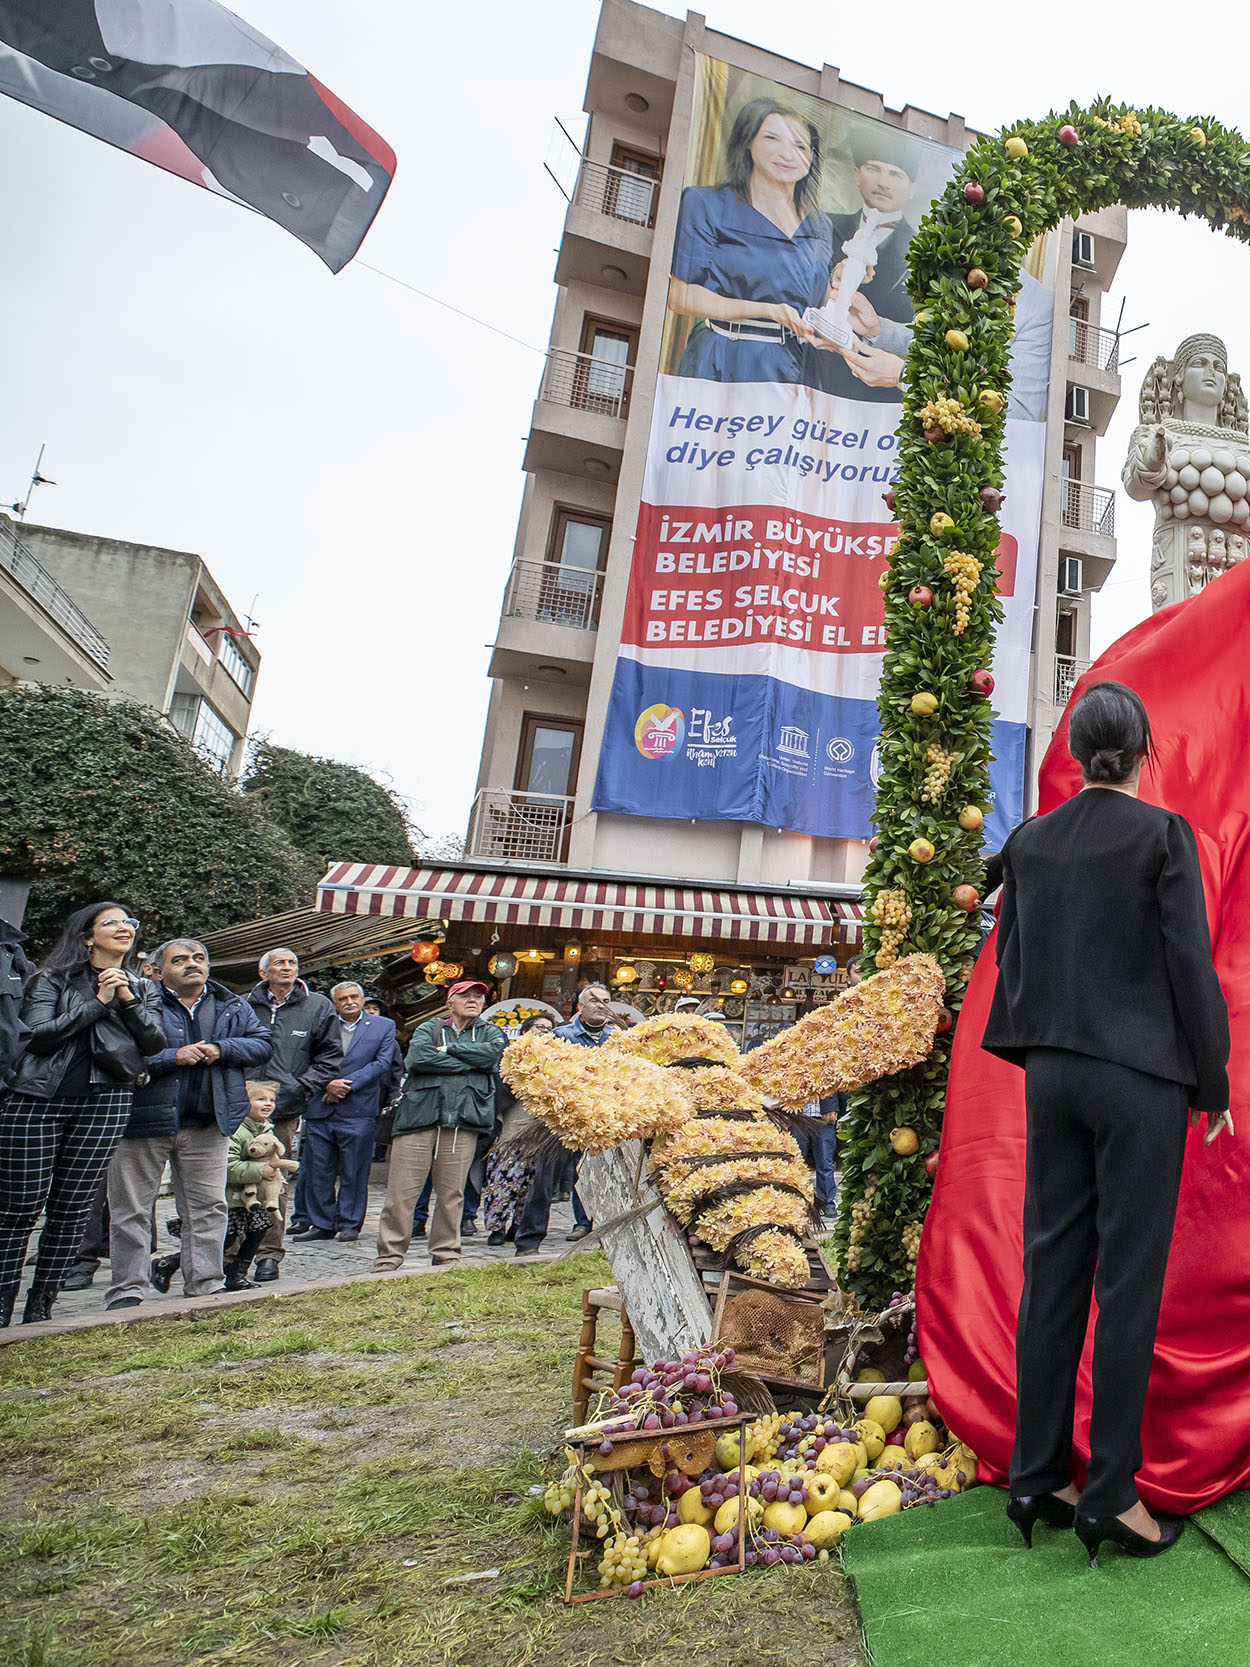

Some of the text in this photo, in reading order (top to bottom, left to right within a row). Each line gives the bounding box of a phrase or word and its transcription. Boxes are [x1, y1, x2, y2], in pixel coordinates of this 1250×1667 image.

[669, 406, 784, 439] Herşey
[792, 419, 869, 449] güzel
[666, 442, 735, 471] diye
[659, 514, 754, 543] İZMİR
[655, 542, 820, 578] BELEDİYESİ
[650, 585, 840, 617] EFES SELÇUK
[646, 609, 812, 642] BELEDİYESİ
[822, 625, 850, 646] EL
[688, 708, 733, 743] Efes
